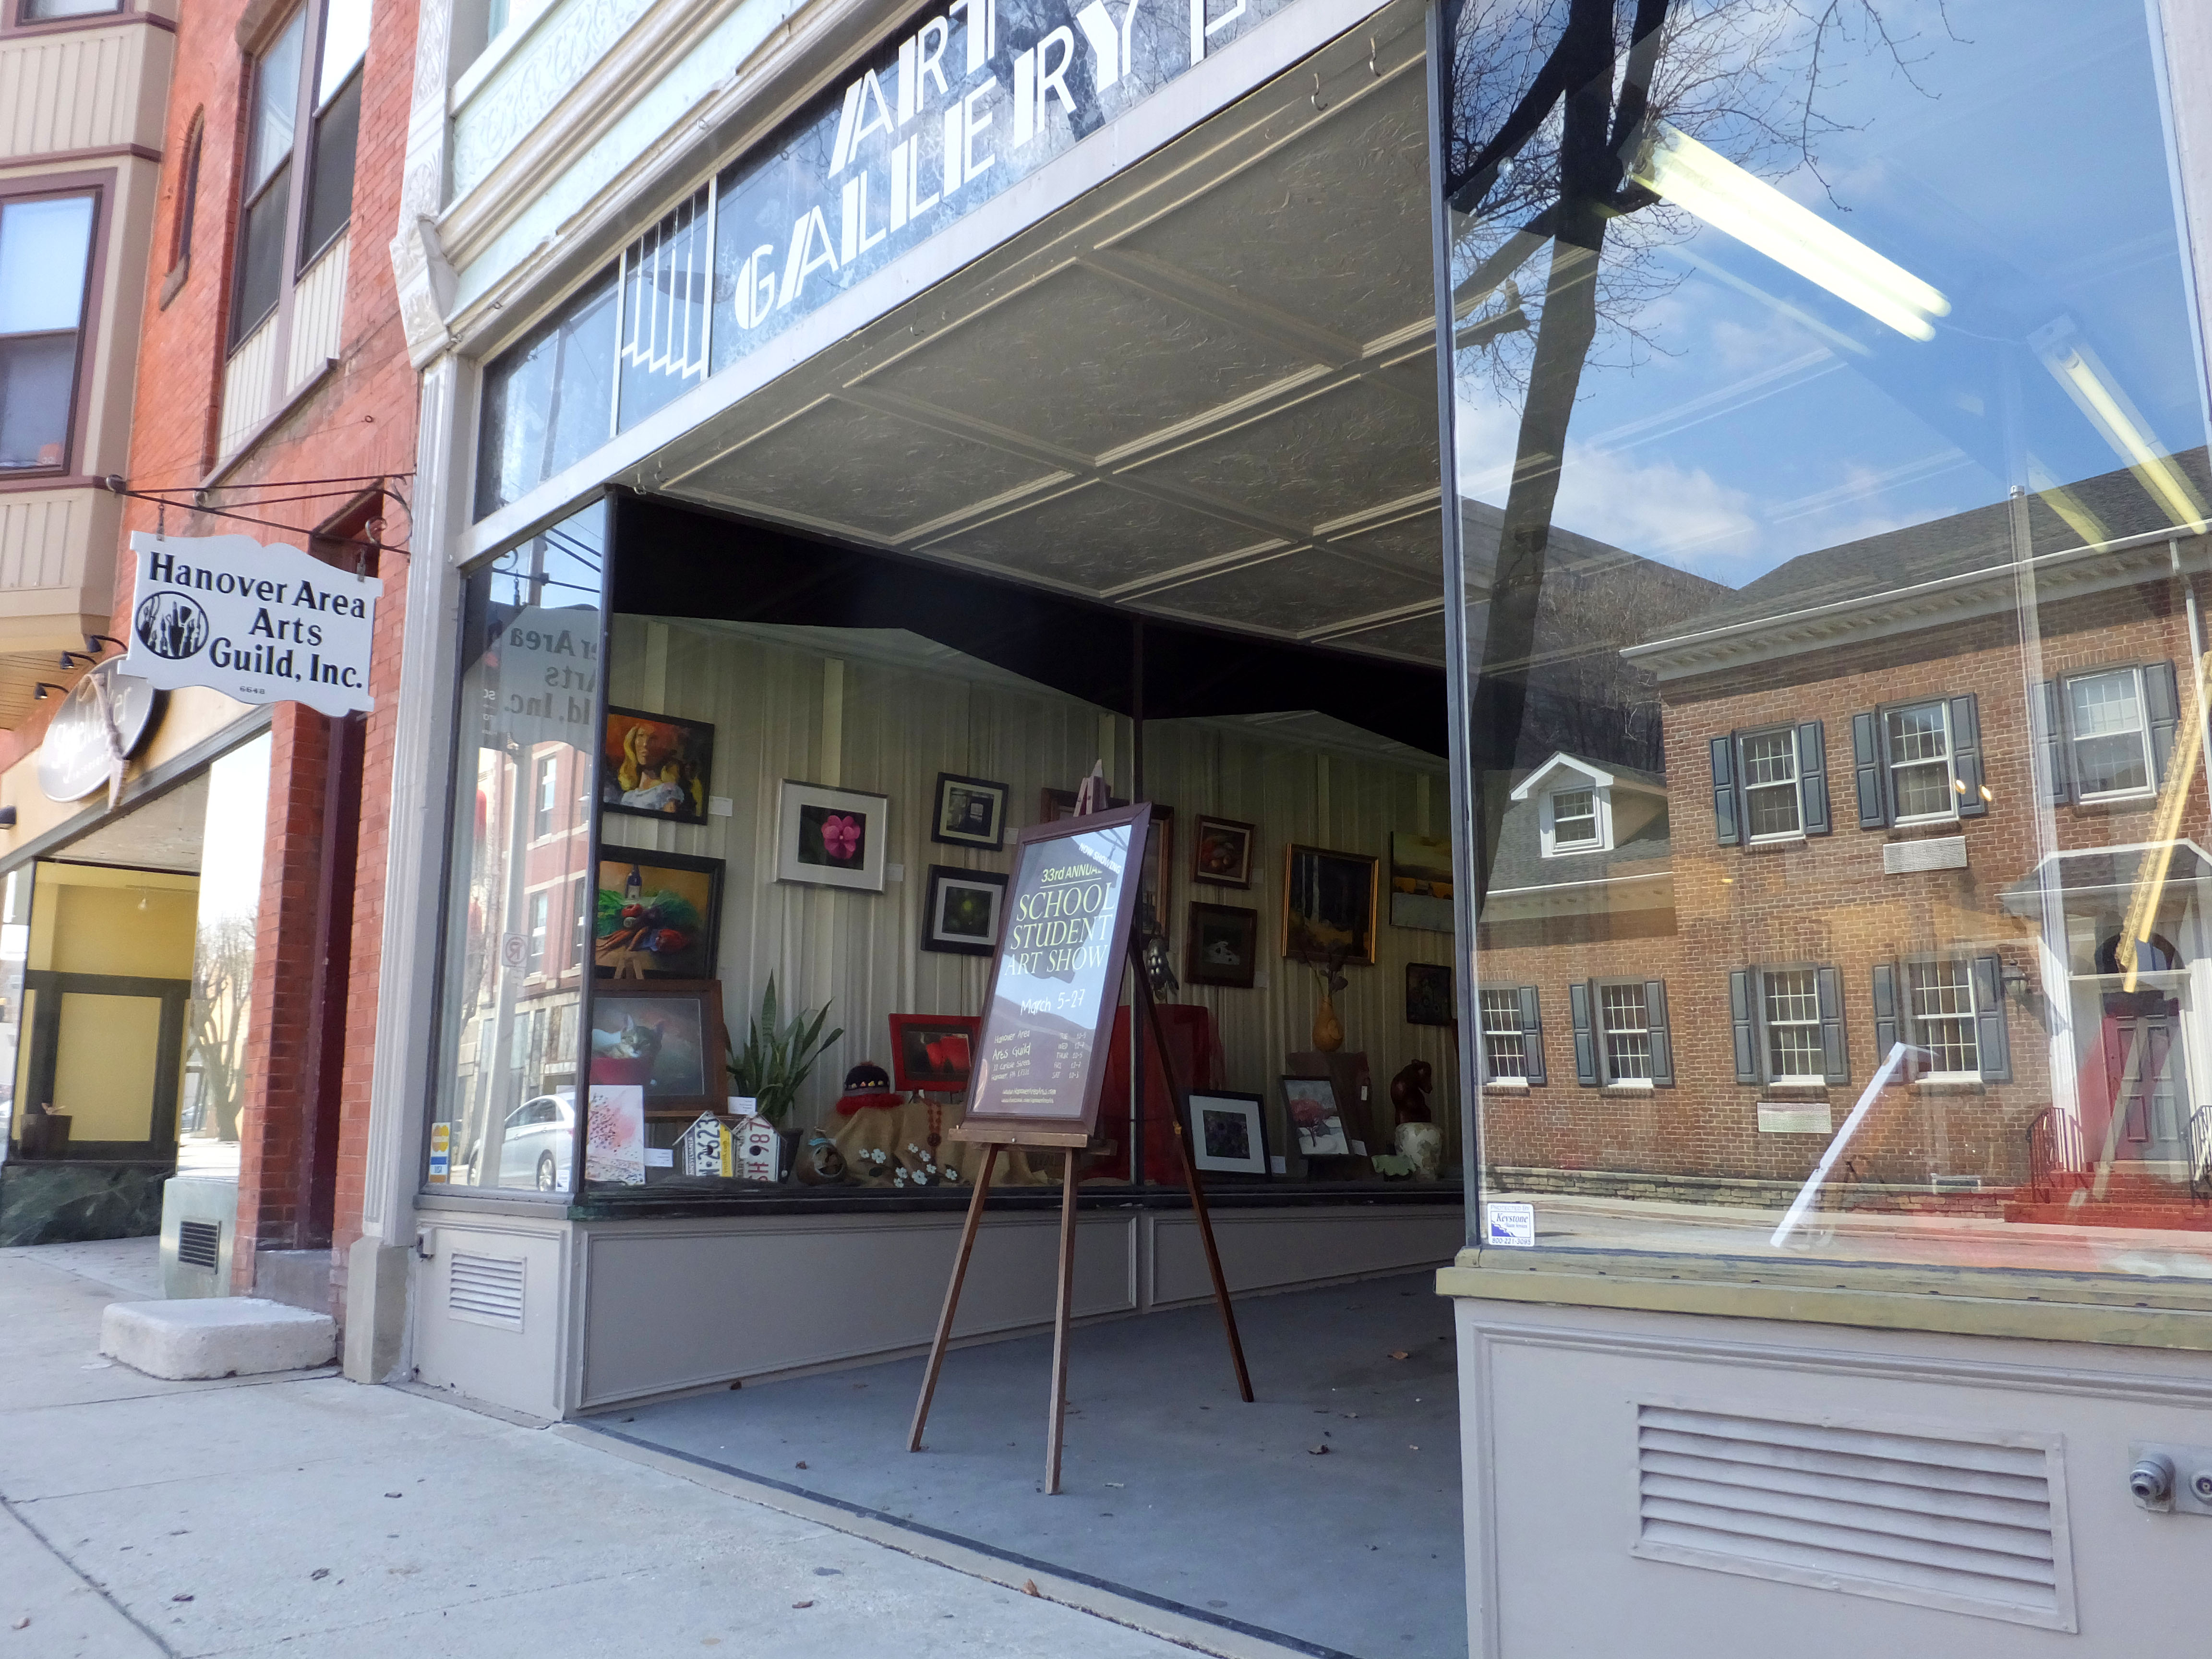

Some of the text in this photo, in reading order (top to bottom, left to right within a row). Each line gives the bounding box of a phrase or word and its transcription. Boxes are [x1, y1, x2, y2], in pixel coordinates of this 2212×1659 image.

[827, 0, 997, 180] ART
[734, 0, 1136, 330] GALLERY
[148, 551, 366, 619] Hanover Area
[248, 607, 322, 646] Arts
[209, 637, 362, 688] Guild, Inc.
[1041, 866, 1065, 882] 33rd
[1079, 842, 1121, 874] NOW SHOWING
[1016, 882, 1116, 922] SCHOOL
[1010, 914, 1113, 950] STUDENT
[1005, 944, 1108, 976] ART SHOW
[1020, 988, 1086, 1015] March 5-27
[1012, 1042, 1031, 1057] Guild
[1497, 1213, 1528, 1223] Keystone
